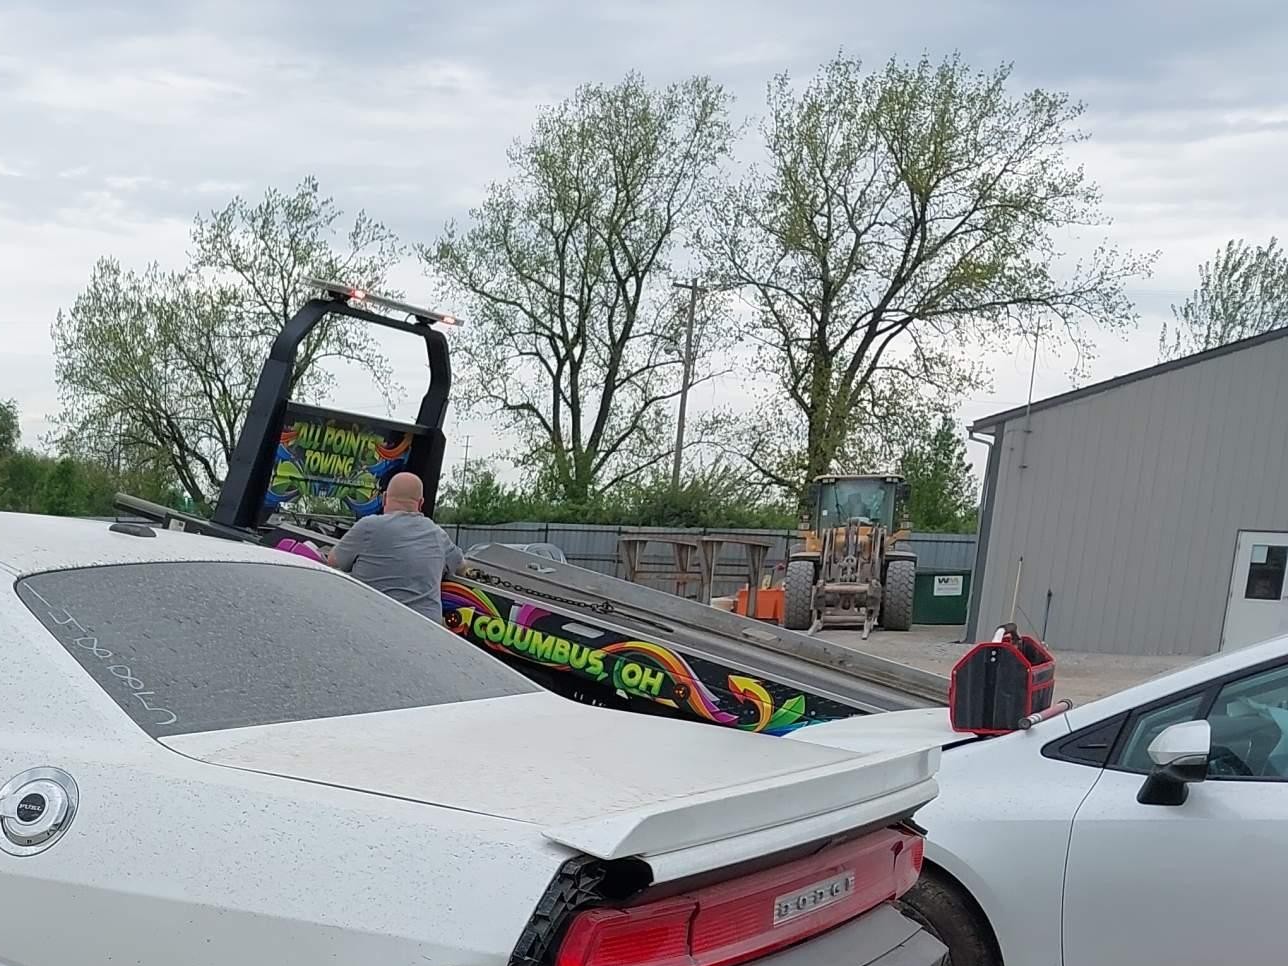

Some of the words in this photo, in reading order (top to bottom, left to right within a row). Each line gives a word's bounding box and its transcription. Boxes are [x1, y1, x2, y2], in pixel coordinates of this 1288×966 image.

[298, 422, 321, 450] ALL
[322, 425, 376, 456] POINTS
[305, 450, 354, 477] TOWING
[23, 582, 178, 726] 14885
[473, 614, 609, 681] COLUMBUS,
[619, 662, 665, 696] OH
